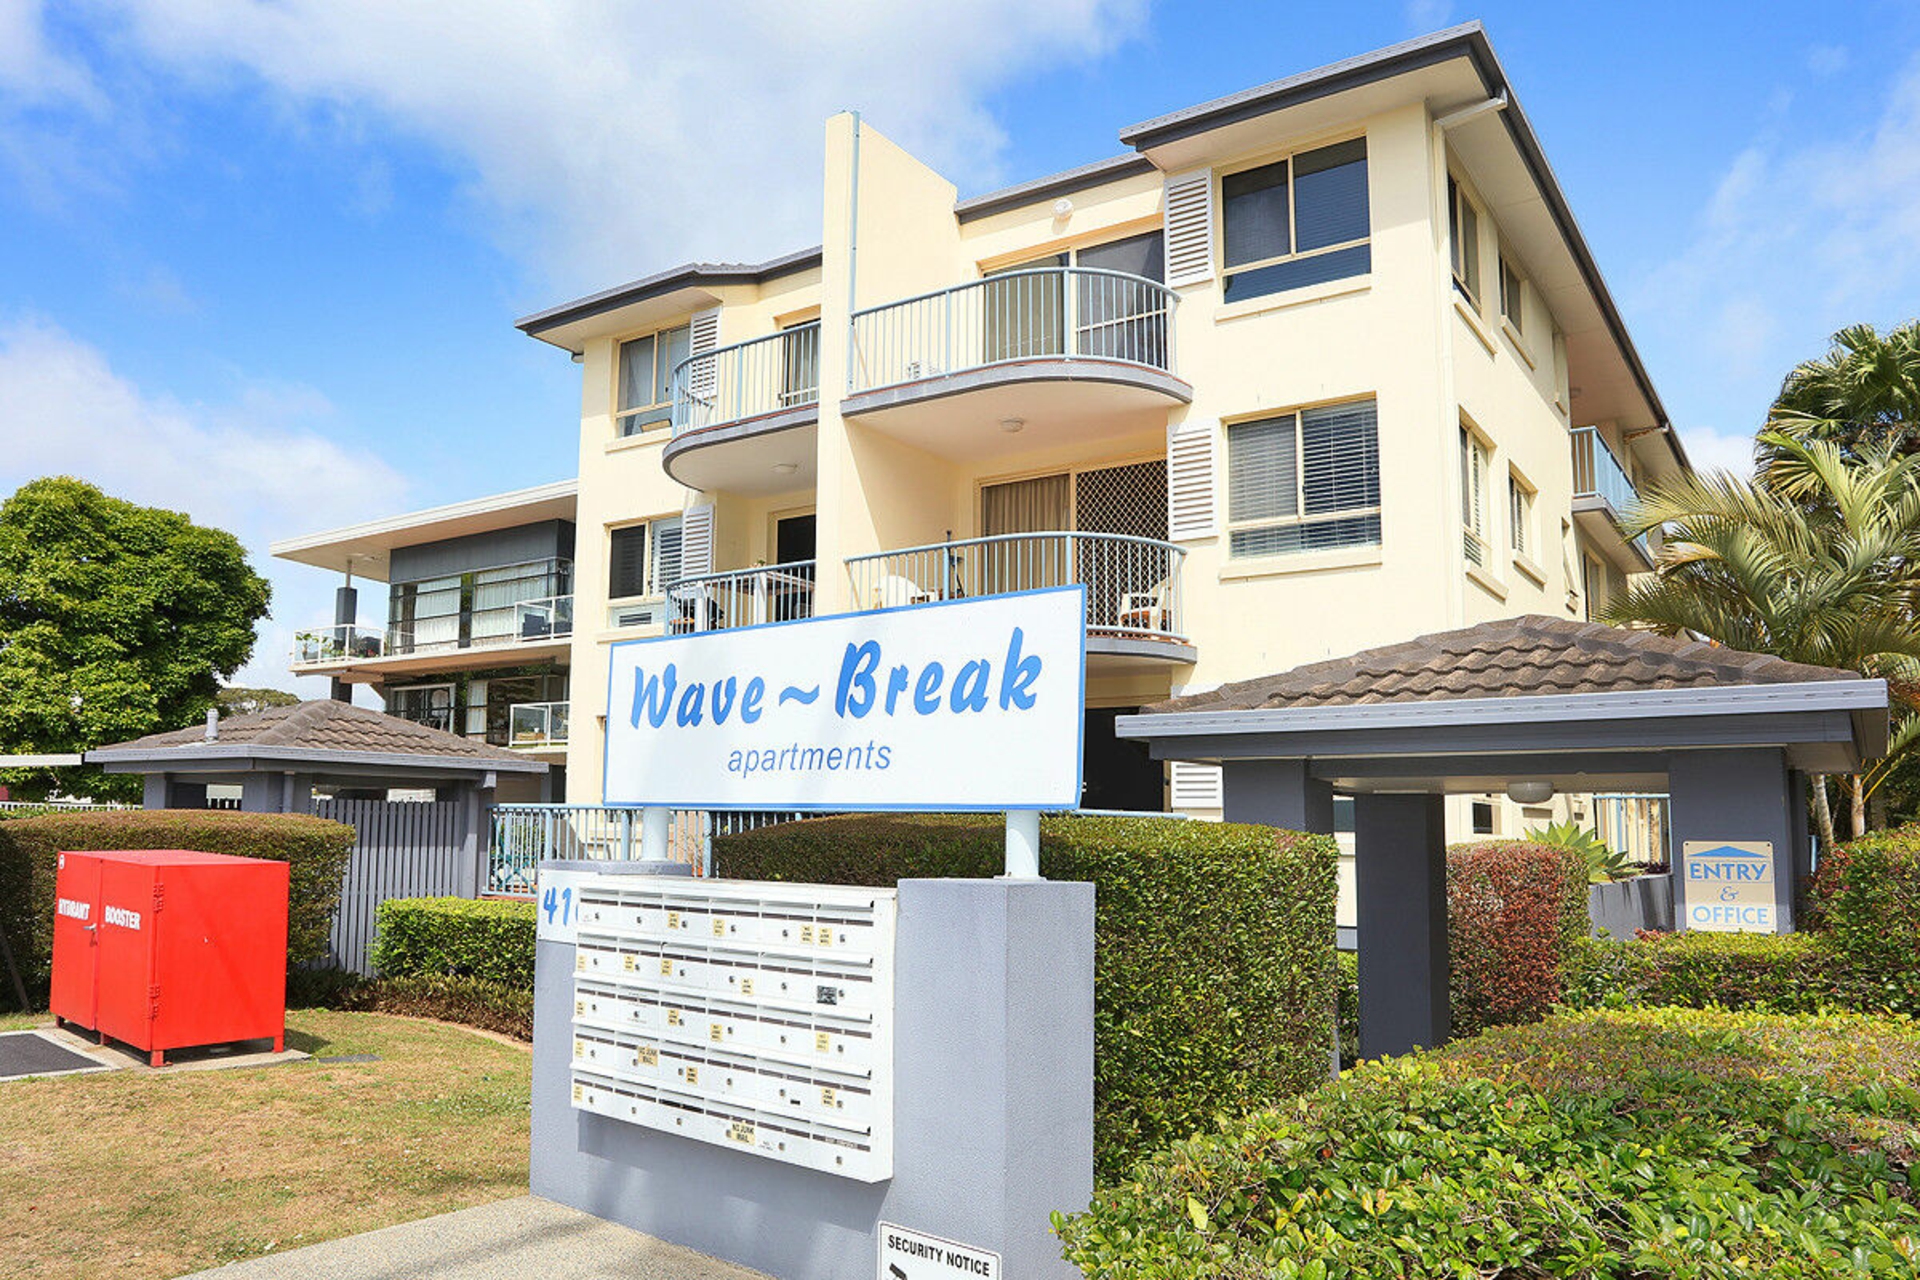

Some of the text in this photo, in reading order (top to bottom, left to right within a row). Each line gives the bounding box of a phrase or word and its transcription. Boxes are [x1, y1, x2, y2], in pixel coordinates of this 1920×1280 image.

[630, 663, 766, 730] Wave
[834, 626, 1043, 719] Break
[727, 740, 892, 779] apartments
[1689, 863, 1767, 881] ENTRY
[543, 886, 579, 927] 41
[1720, 886, 1739, 902] &
[105, 905, 141, 931] BOOSTER
[1692, 905, 1768, 925] OFFICE
[887, 1234, 990, 1277] SECURITY NOTICE
